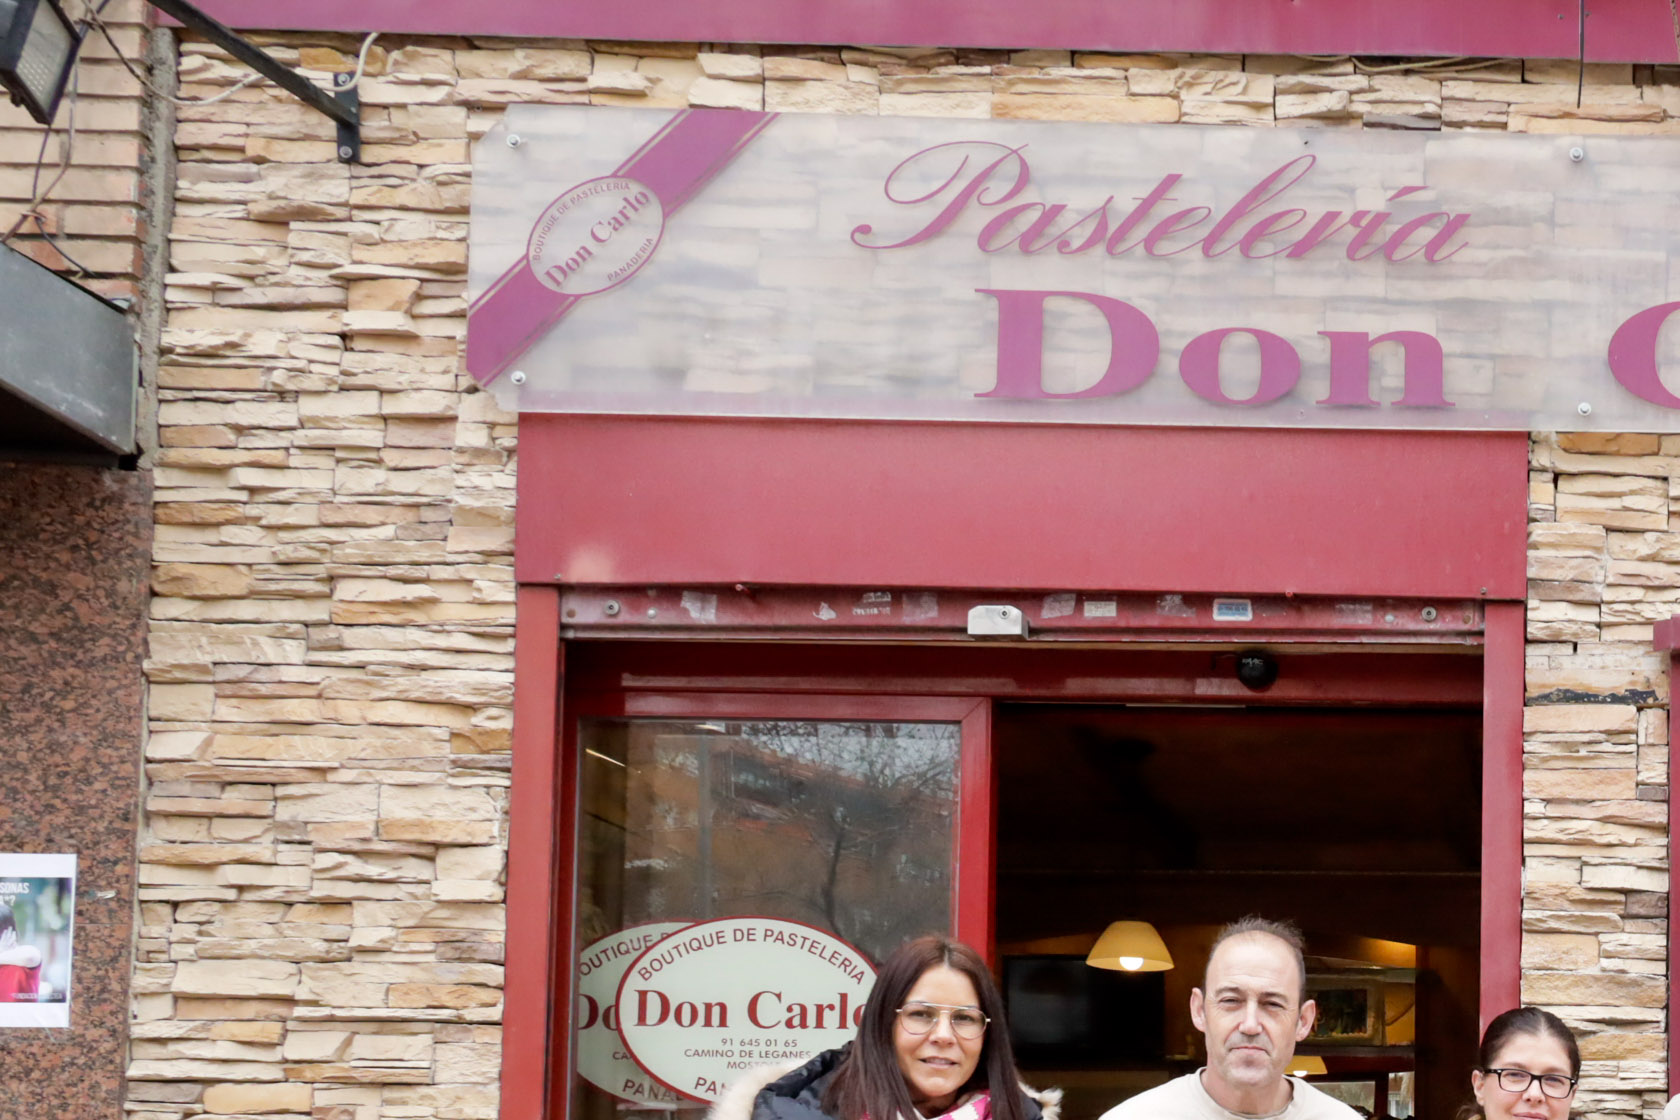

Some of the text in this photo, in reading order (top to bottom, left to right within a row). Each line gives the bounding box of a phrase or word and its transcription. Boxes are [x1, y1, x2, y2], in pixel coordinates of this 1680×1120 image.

[850, 140, 1471, 263] Pastelería
[532, 213, 560, 261] BOUTIQUE
[556, 201, 570, 215] DE
[544, 191, 650, 287] Don Carlo
[607, 237, 654, 282] PANADERIA
[973, 288, 1456, 407] Don
[579, 934, 654, 977] OUTIQUE
[638, 928, 866, 985] BOUTIQUE DE PASTELERIA
[578, 993, 617, 1031] Do
[633, 989, 730, 1028] Don
[684, 1049, 812, 1059] CAMINO DE LEGANES
[721, 1038, 798, 1048] 91 645 01 65
